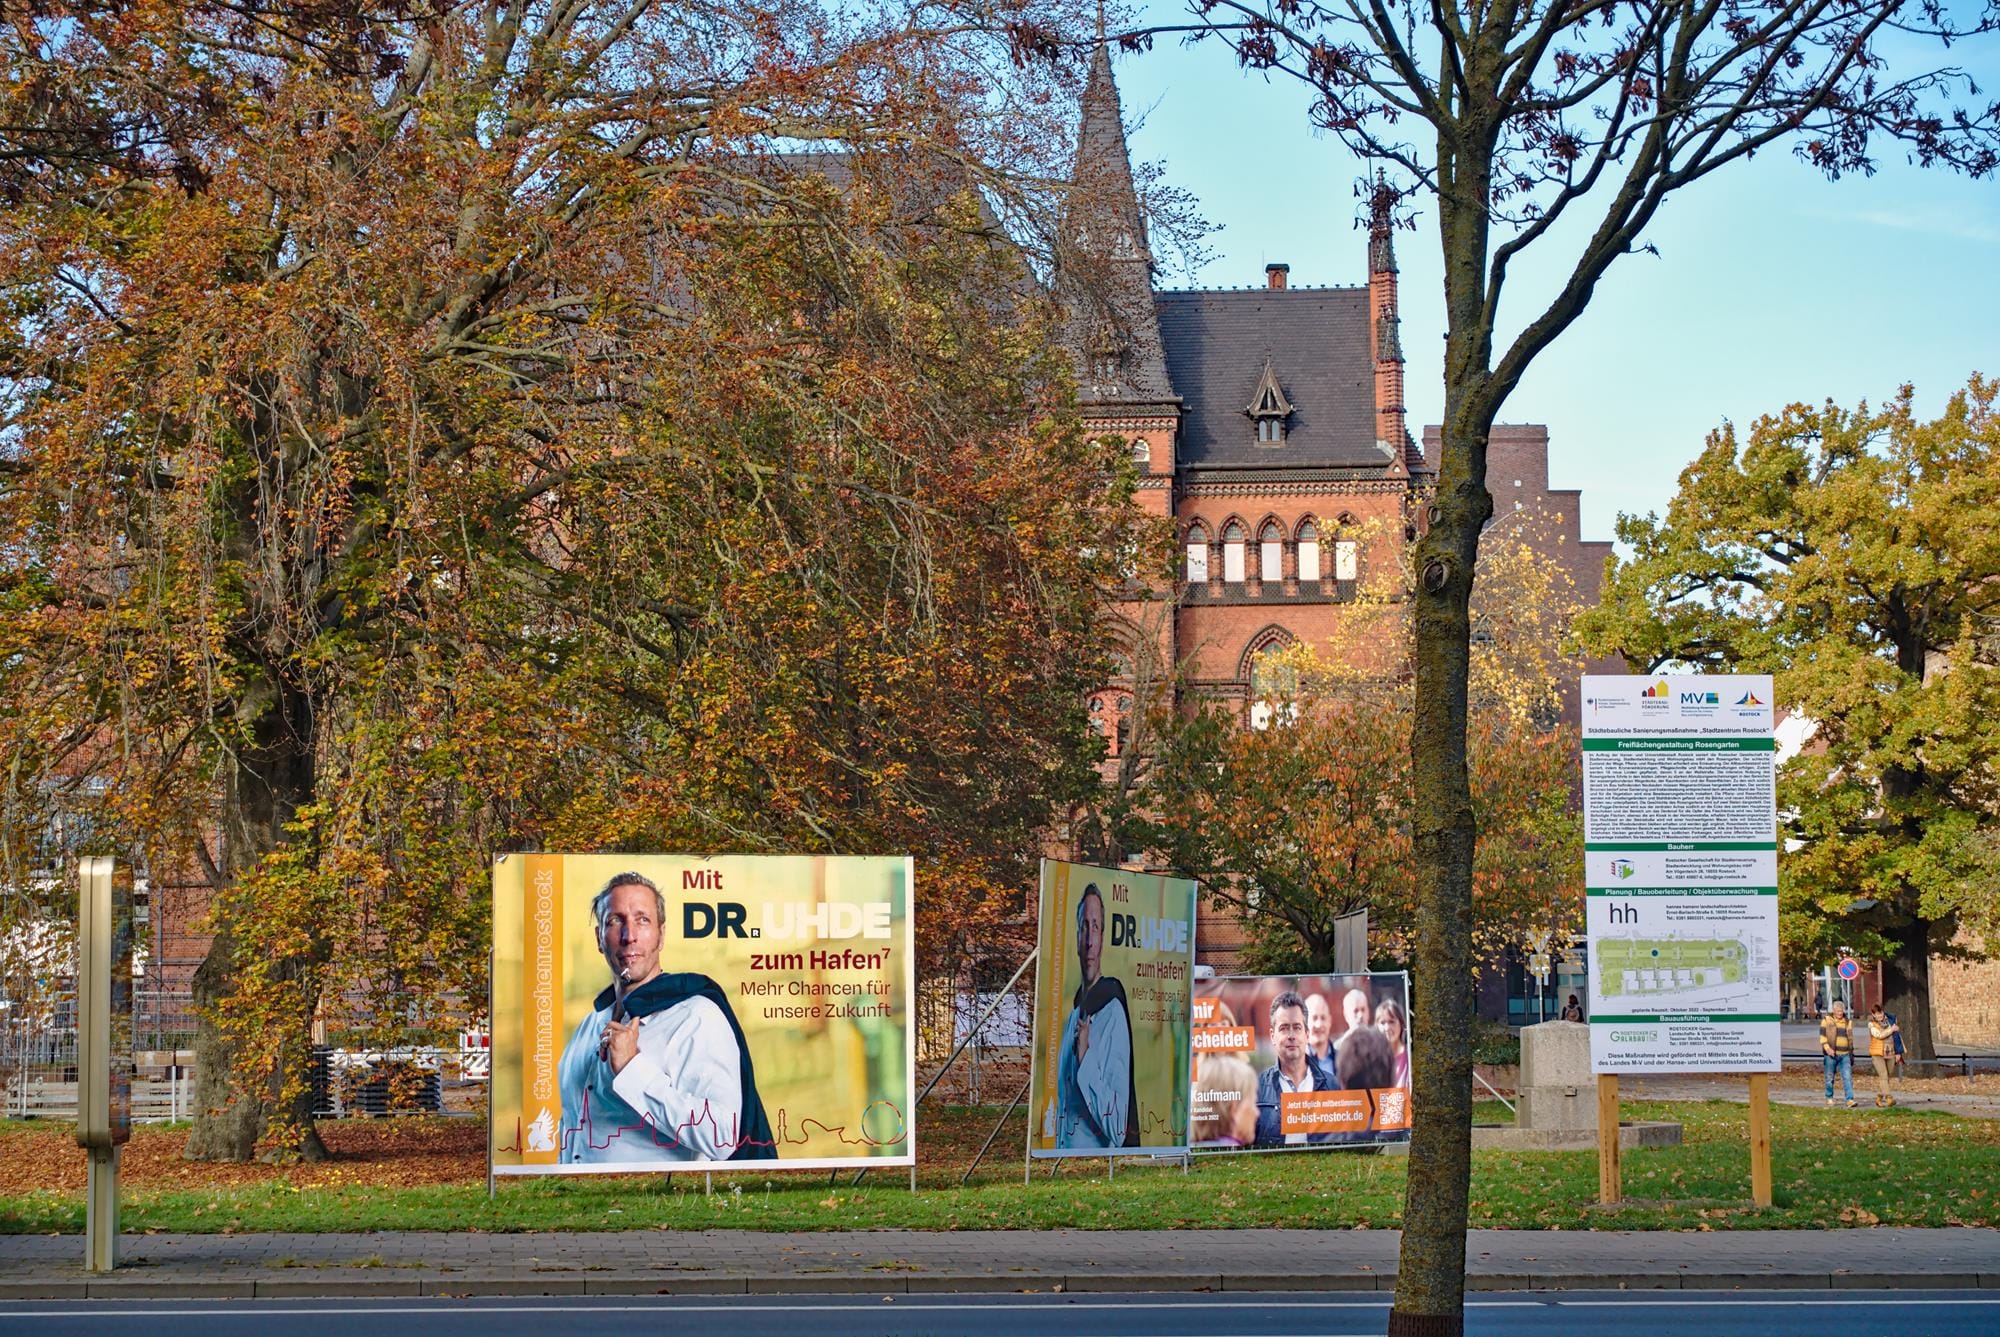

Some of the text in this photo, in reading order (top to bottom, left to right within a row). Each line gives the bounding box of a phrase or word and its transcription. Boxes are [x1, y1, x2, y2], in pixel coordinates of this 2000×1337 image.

[1633, 727, 1697, 735] Sanierungsmaßnahme
[1618, 741, 1740, 750] Freiflächengestaltung Rosengarten
[682, 869, 723, 890] Mit
[1112, 883, 1129, 903] Mit
[1605, 888, 1633, 897] Planung
[1638, 888, 1688, 897] Bauoberleitung
[1692, 888, 1759, 896] Objektüberwachung
[1609, 902, 1638, 924] hh
[750, 953, 803, 970] zum
[1136, 962, 1155, 979] zum
[533, 869, 553, 1100] #wirmachenrostock
[740, 980, 891, 996] Mehr Chancen für
[1132, 986, 1150, 1001] Mehr
[1150, 988, 1176, 1003] Chancen
[763, 1002, 891, 1019] unsere Zukunft
[1139, 1008, 1161, 1022] unsere
[1659, 1015, 1710, 1023] Bauausführung
[1286, 1101, 1302, 1109] Jetzt
[1302, 1100, 1321, 1110] täglich
[1286, 1110, 1364, 1125] du-bist-rostock.de
